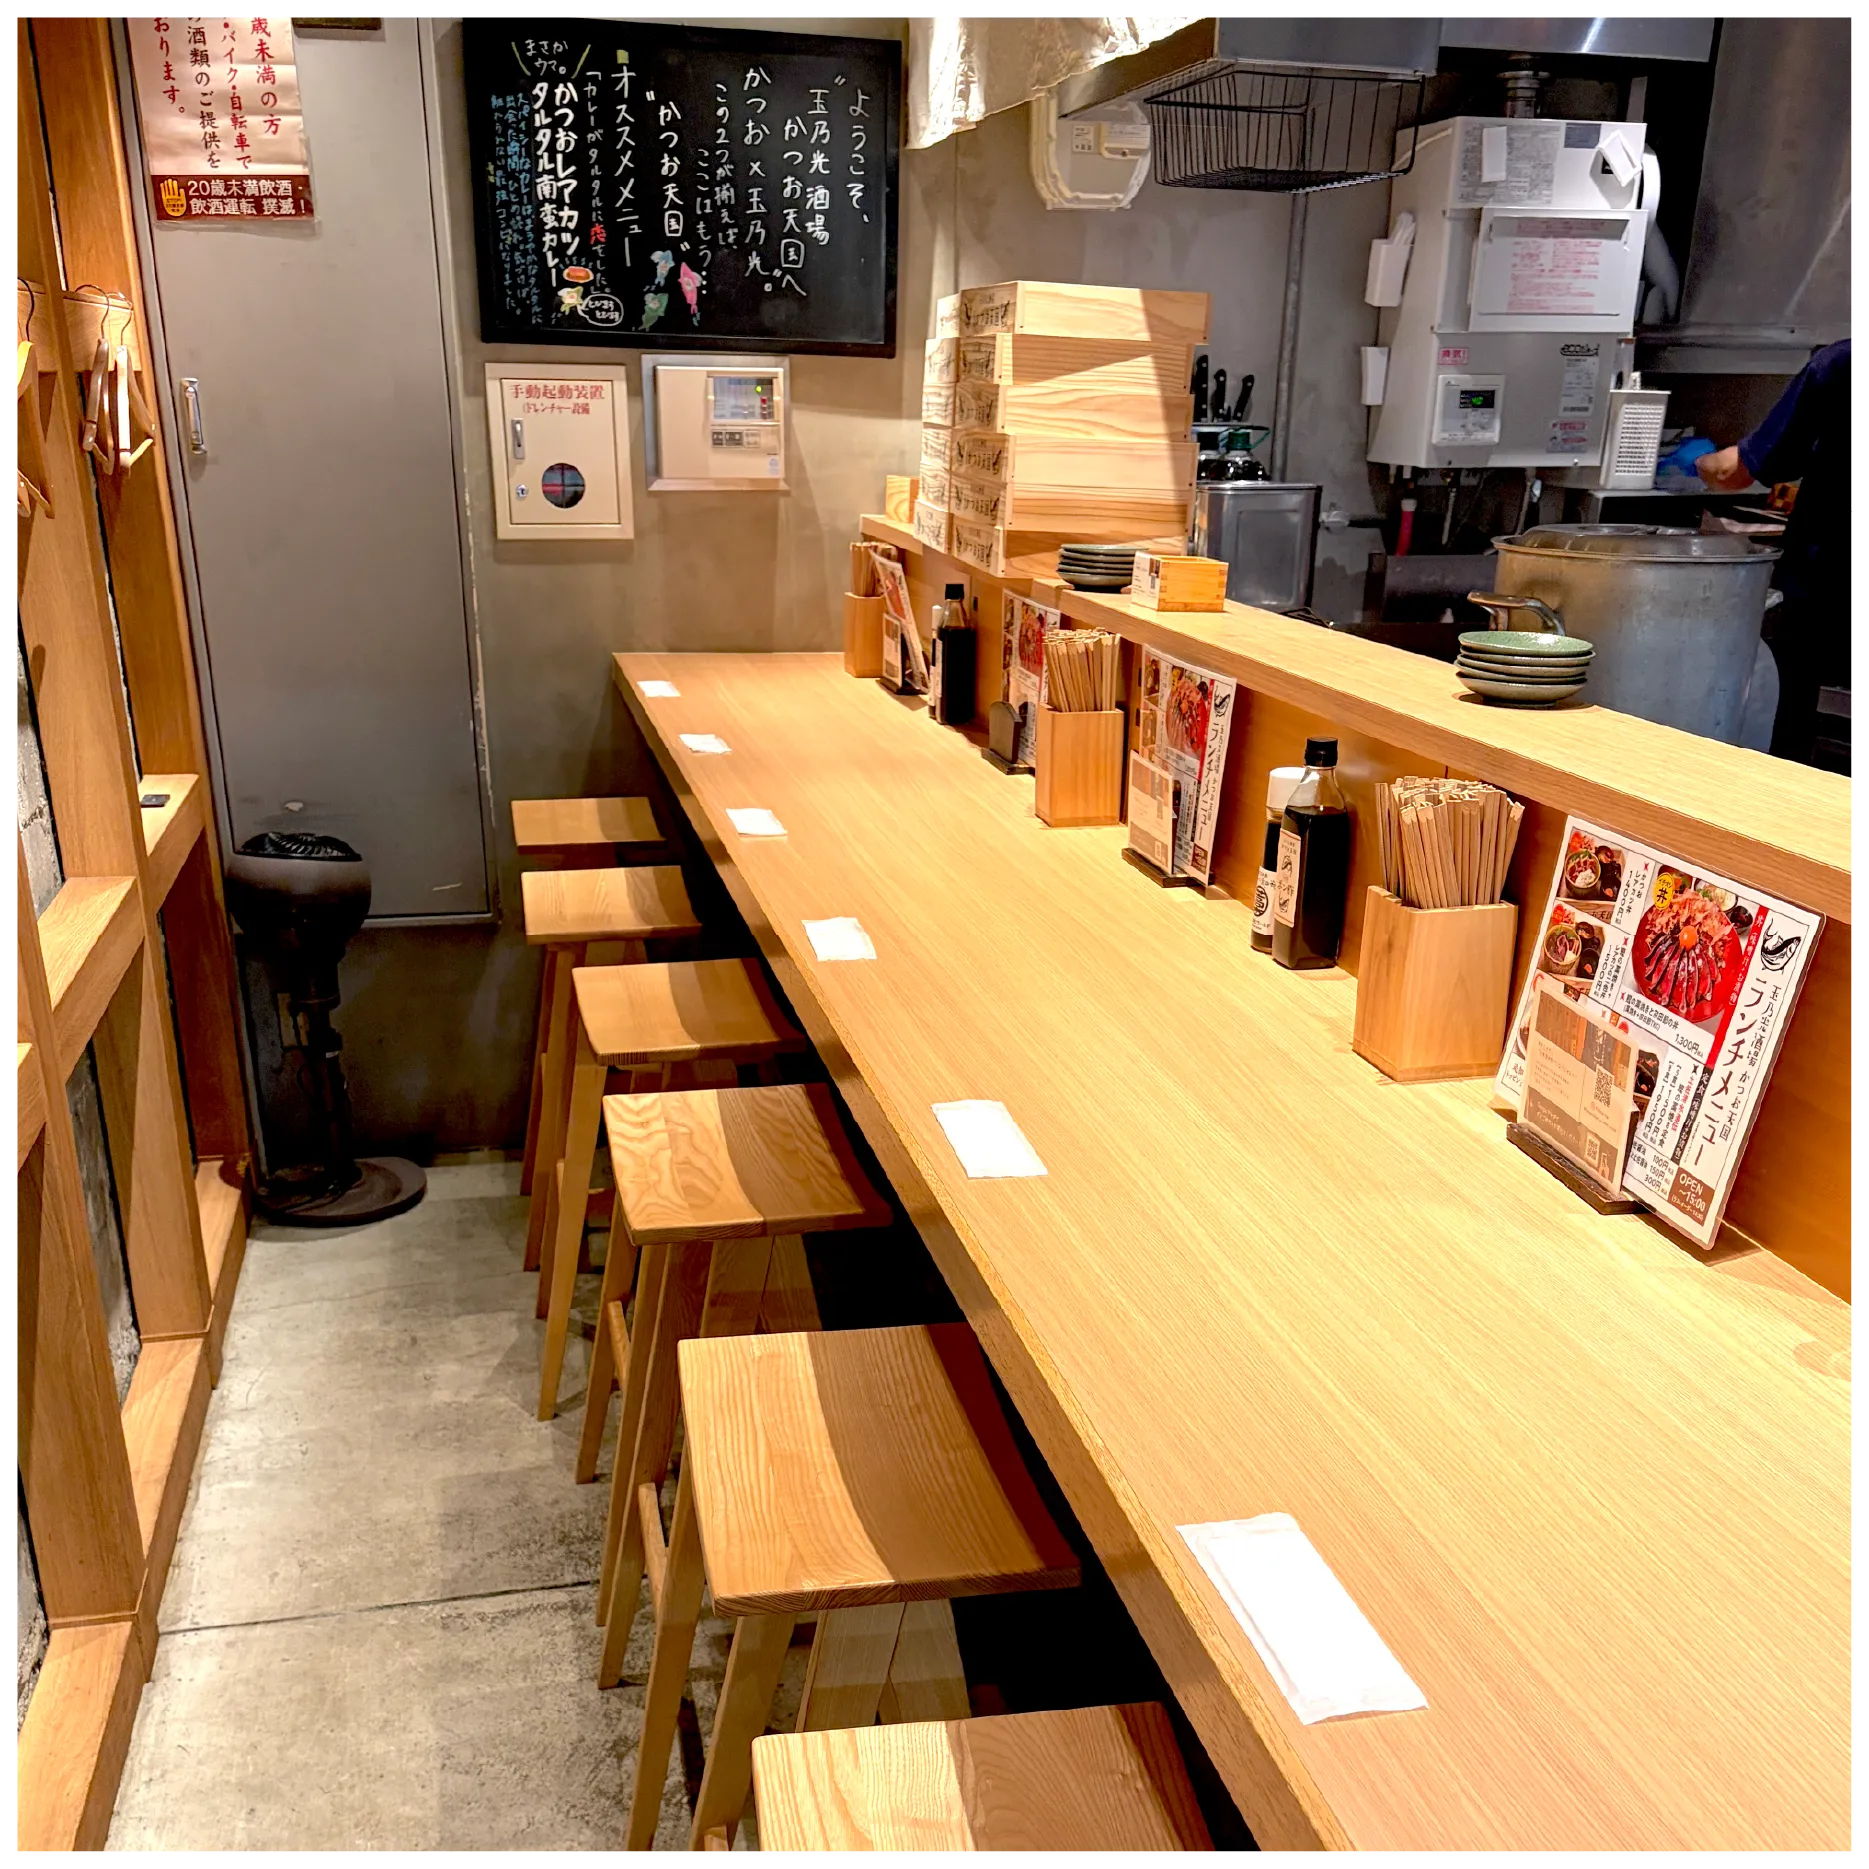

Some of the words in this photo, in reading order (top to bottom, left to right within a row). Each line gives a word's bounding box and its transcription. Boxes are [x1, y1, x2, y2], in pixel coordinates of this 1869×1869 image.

[221, 16, 253, 169] ・バイク・自転車で
[532, 82, 560, 287] タルタル南蛮カレー
[554, 81, 580, 256] かつおレアカツ
[190, 198, 257, 215] 飲酒運転
[509, 384, 605, 400] 手動起動装置
[1656, 887, 1668, 904] 丼
[1674, 1033, 1700, 1054] 1,300円
[1694, 977, 1768, 1166] ランチメニュー
[1718, 1070, 1751, 1143] かつお天国
[1679, 1172, 1704, 1196] OPEN
